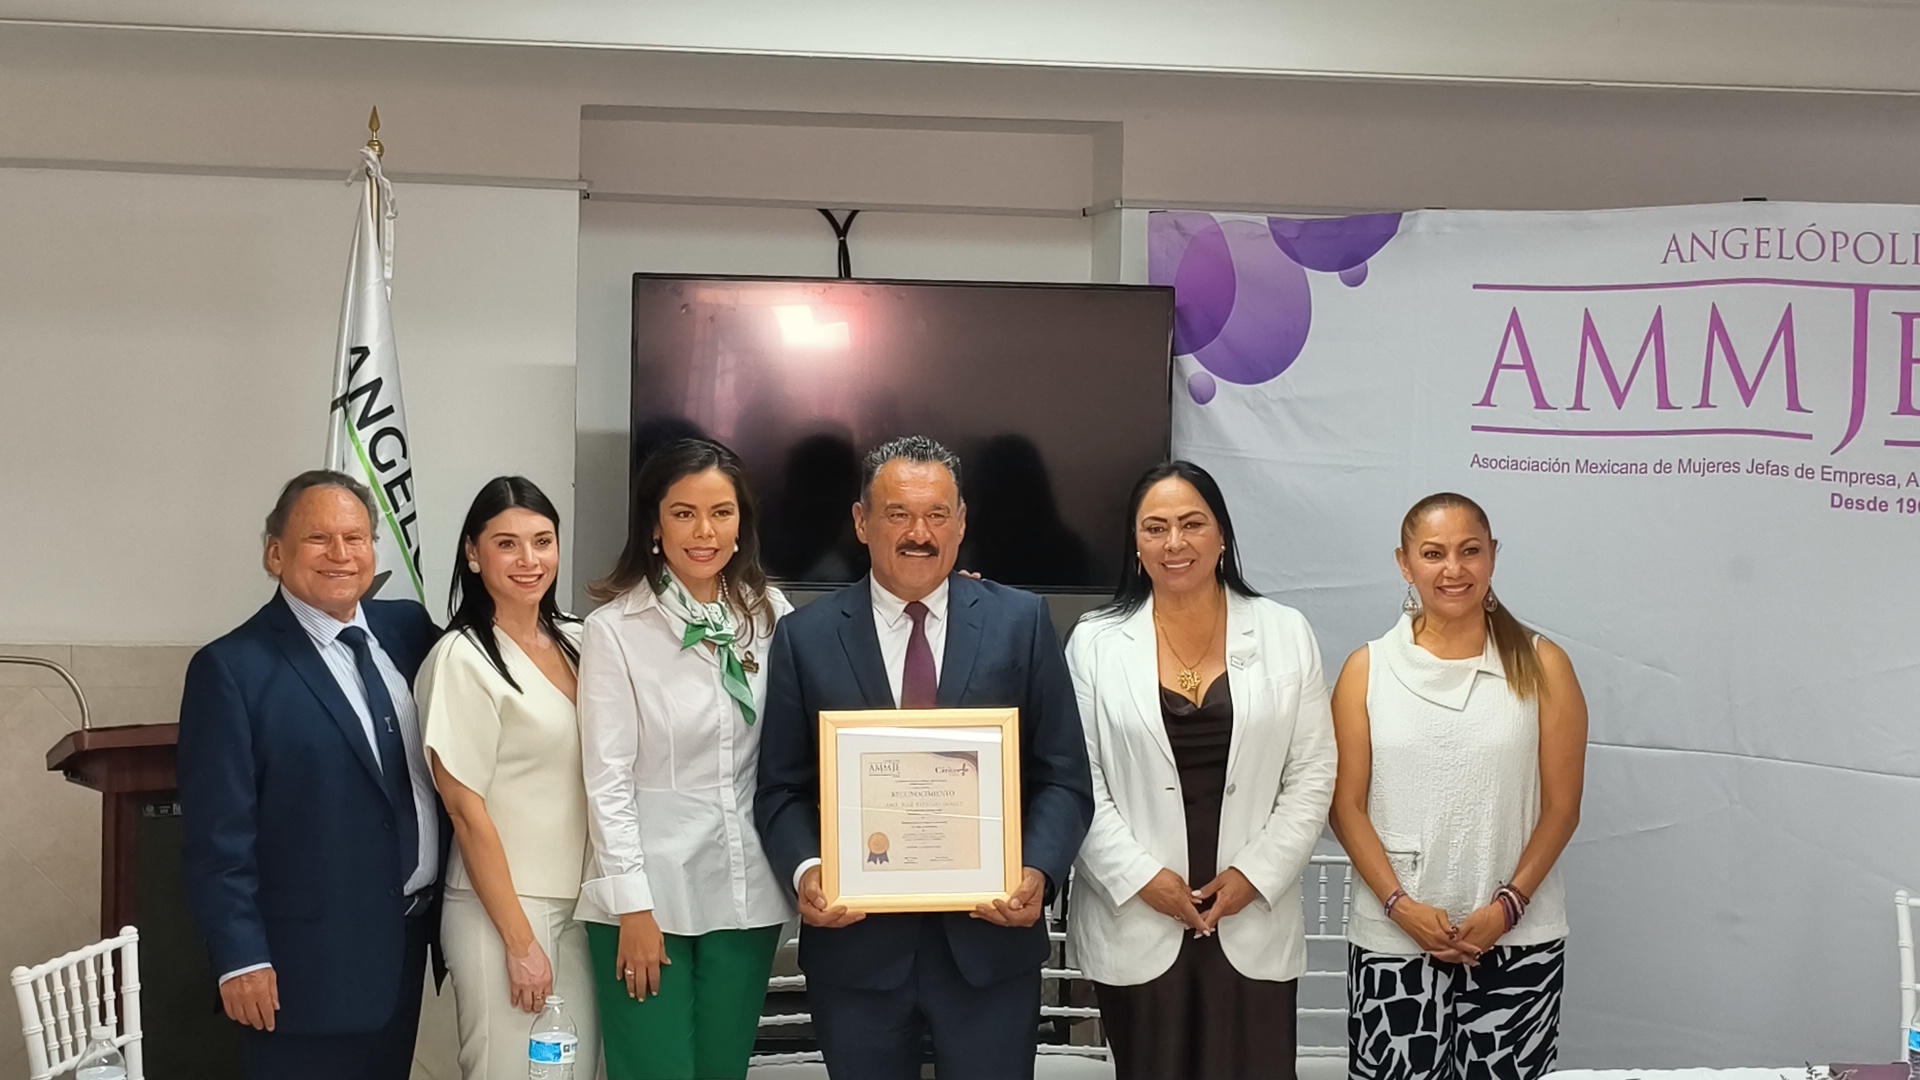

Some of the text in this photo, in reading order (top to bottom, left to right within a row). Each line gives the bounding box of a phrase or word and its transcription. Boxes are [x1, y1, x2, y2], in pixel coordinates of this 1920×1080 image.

[1660, 223, 1920, 265] ANGELÓPOLI
[1470, 453, 1571, 474] Asociaciación
[1575, 458, 1648, 475] Mexicana
[1652, 458, 1673, 475] de
[1677, 457, 1741, 478] Mujeres
[1745, 457, 1790, 478] Jefas
[1794, 462, 1816, 480] de
[1820, 464, 1901, 490] Empresa,
[1830, 492, 1920, 514] Desde 19
